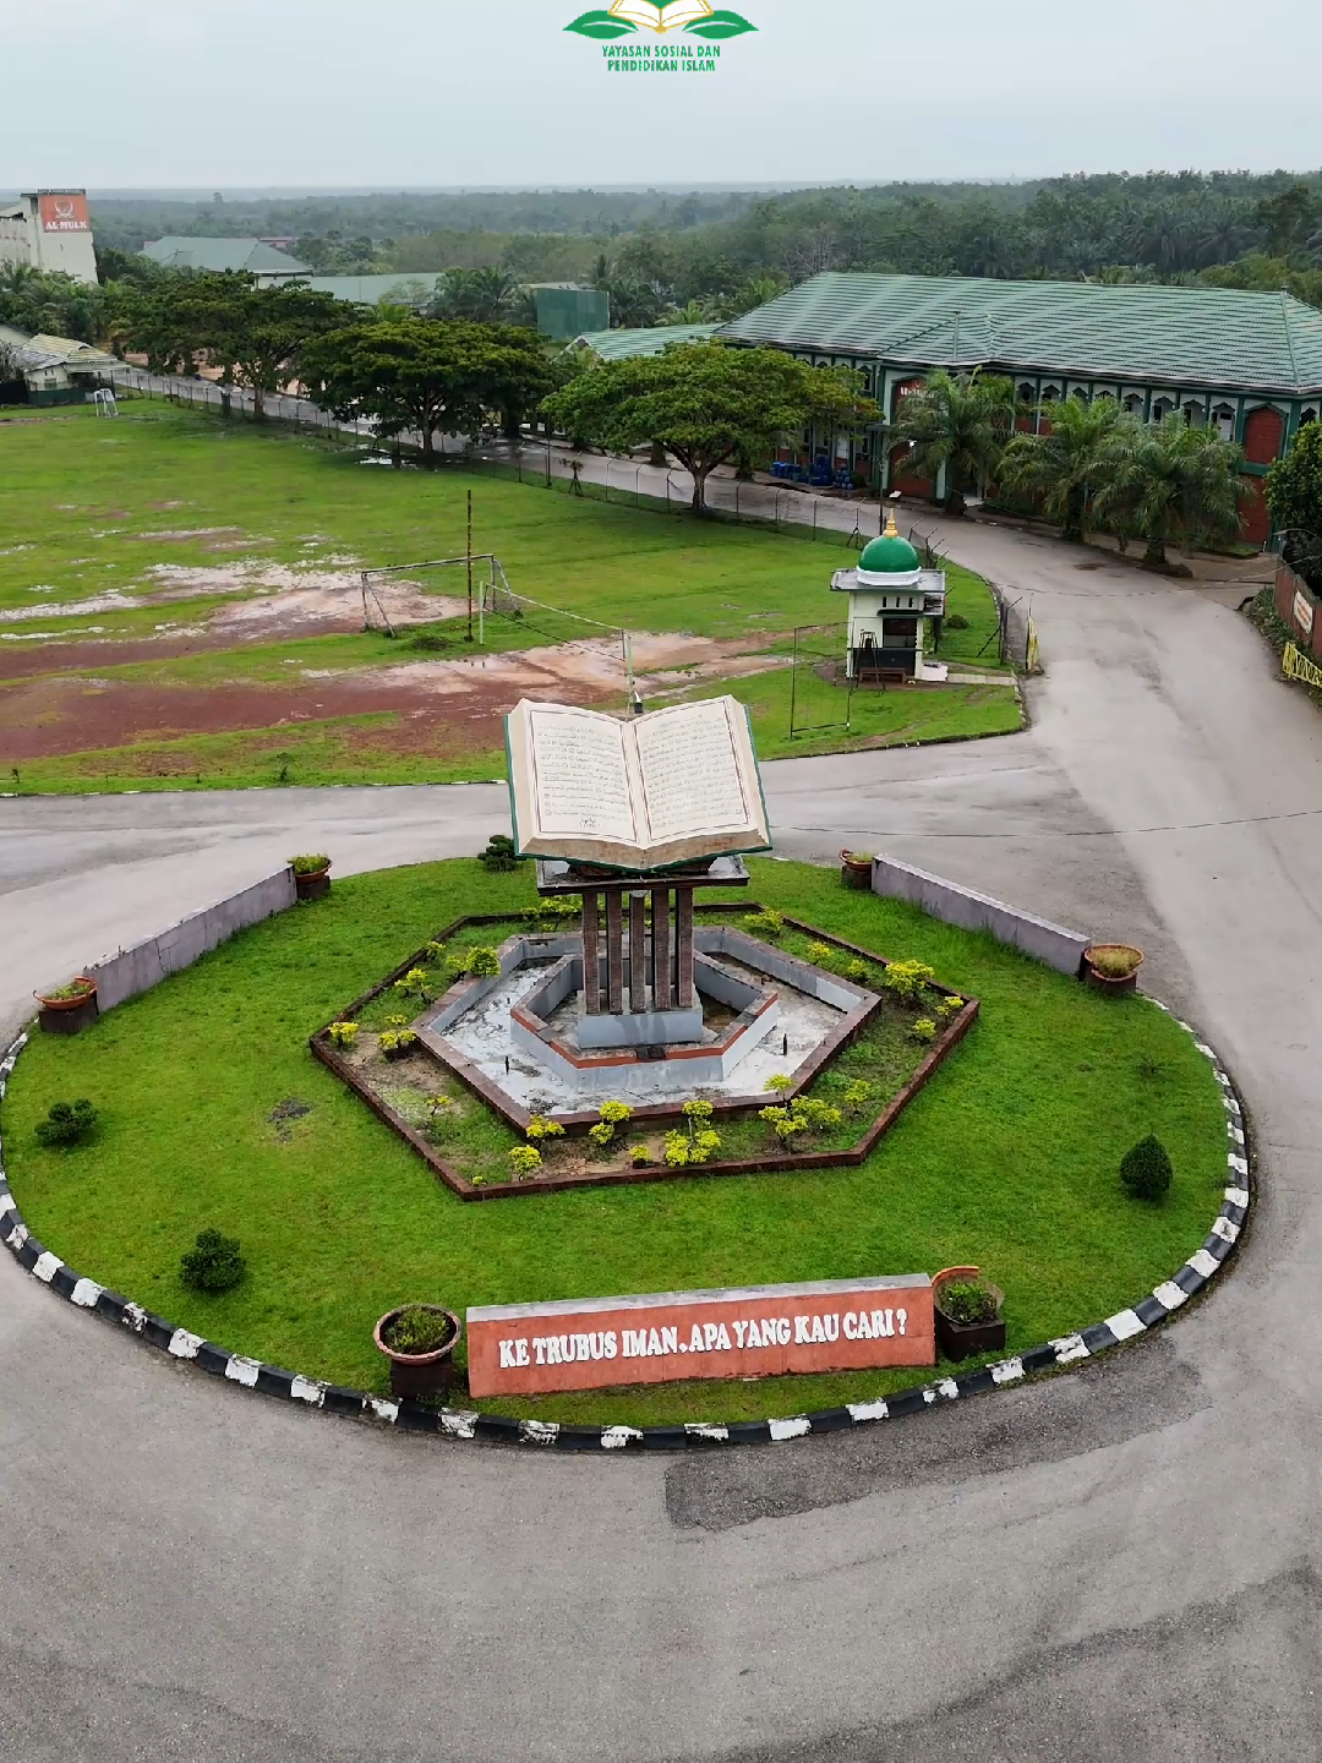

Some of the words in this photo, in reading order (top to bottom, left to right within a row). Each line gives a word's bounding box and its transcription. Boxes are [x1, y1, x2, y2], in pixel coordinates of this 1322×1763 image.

[499, 1338, 530, 1368] KE
[532, 1331, 617, 1365] TRUBUS
[732, 1317, 791, 1349] YANG
[794, 1313, 839, 1344] KAU
